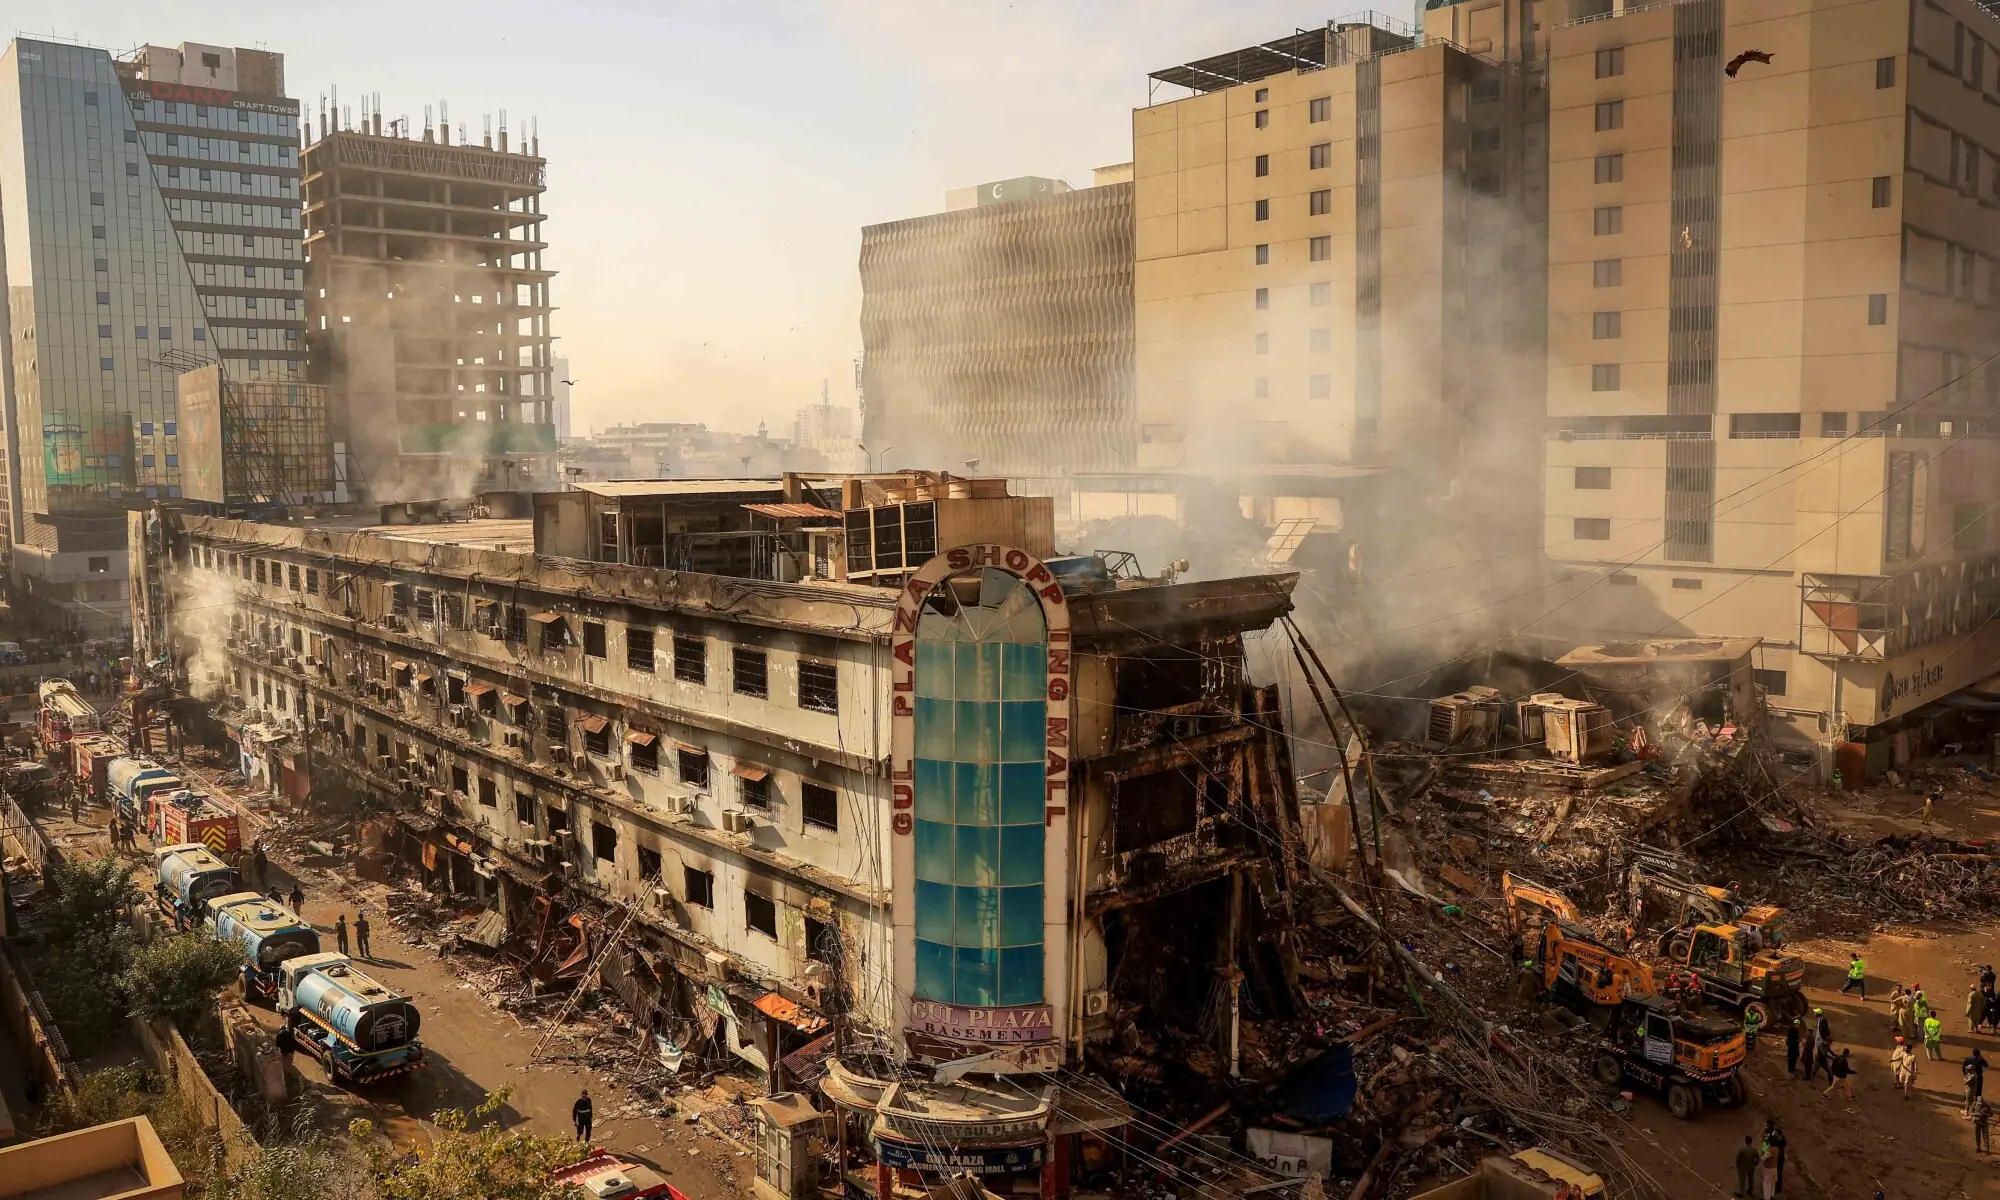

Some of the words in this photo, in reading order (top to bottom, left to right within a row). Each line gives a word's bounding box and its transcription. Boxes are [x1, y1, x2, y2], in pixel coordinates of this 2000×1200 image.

[152, 82, 232, 104] DANY
[233, 100, 264, 111] CRAFT
[267, 104, 299, 115] TOWER
[894, 579, 932, 717] PLAZA
[1046, 717, 1067, 827] MALL
[893, 759, 914, 836] GUL
[1655, 883, 1682, 897] VOLVO
[912, 1002, 960, 1026] GUL
[968, 1008, 1052, 1029] PLAZA
[925, 1022, 1038, 1040] BASEMENT
[949, 1154, 985, 1166] PLAZA
[985, 1164, 1006, 1174] MALL
